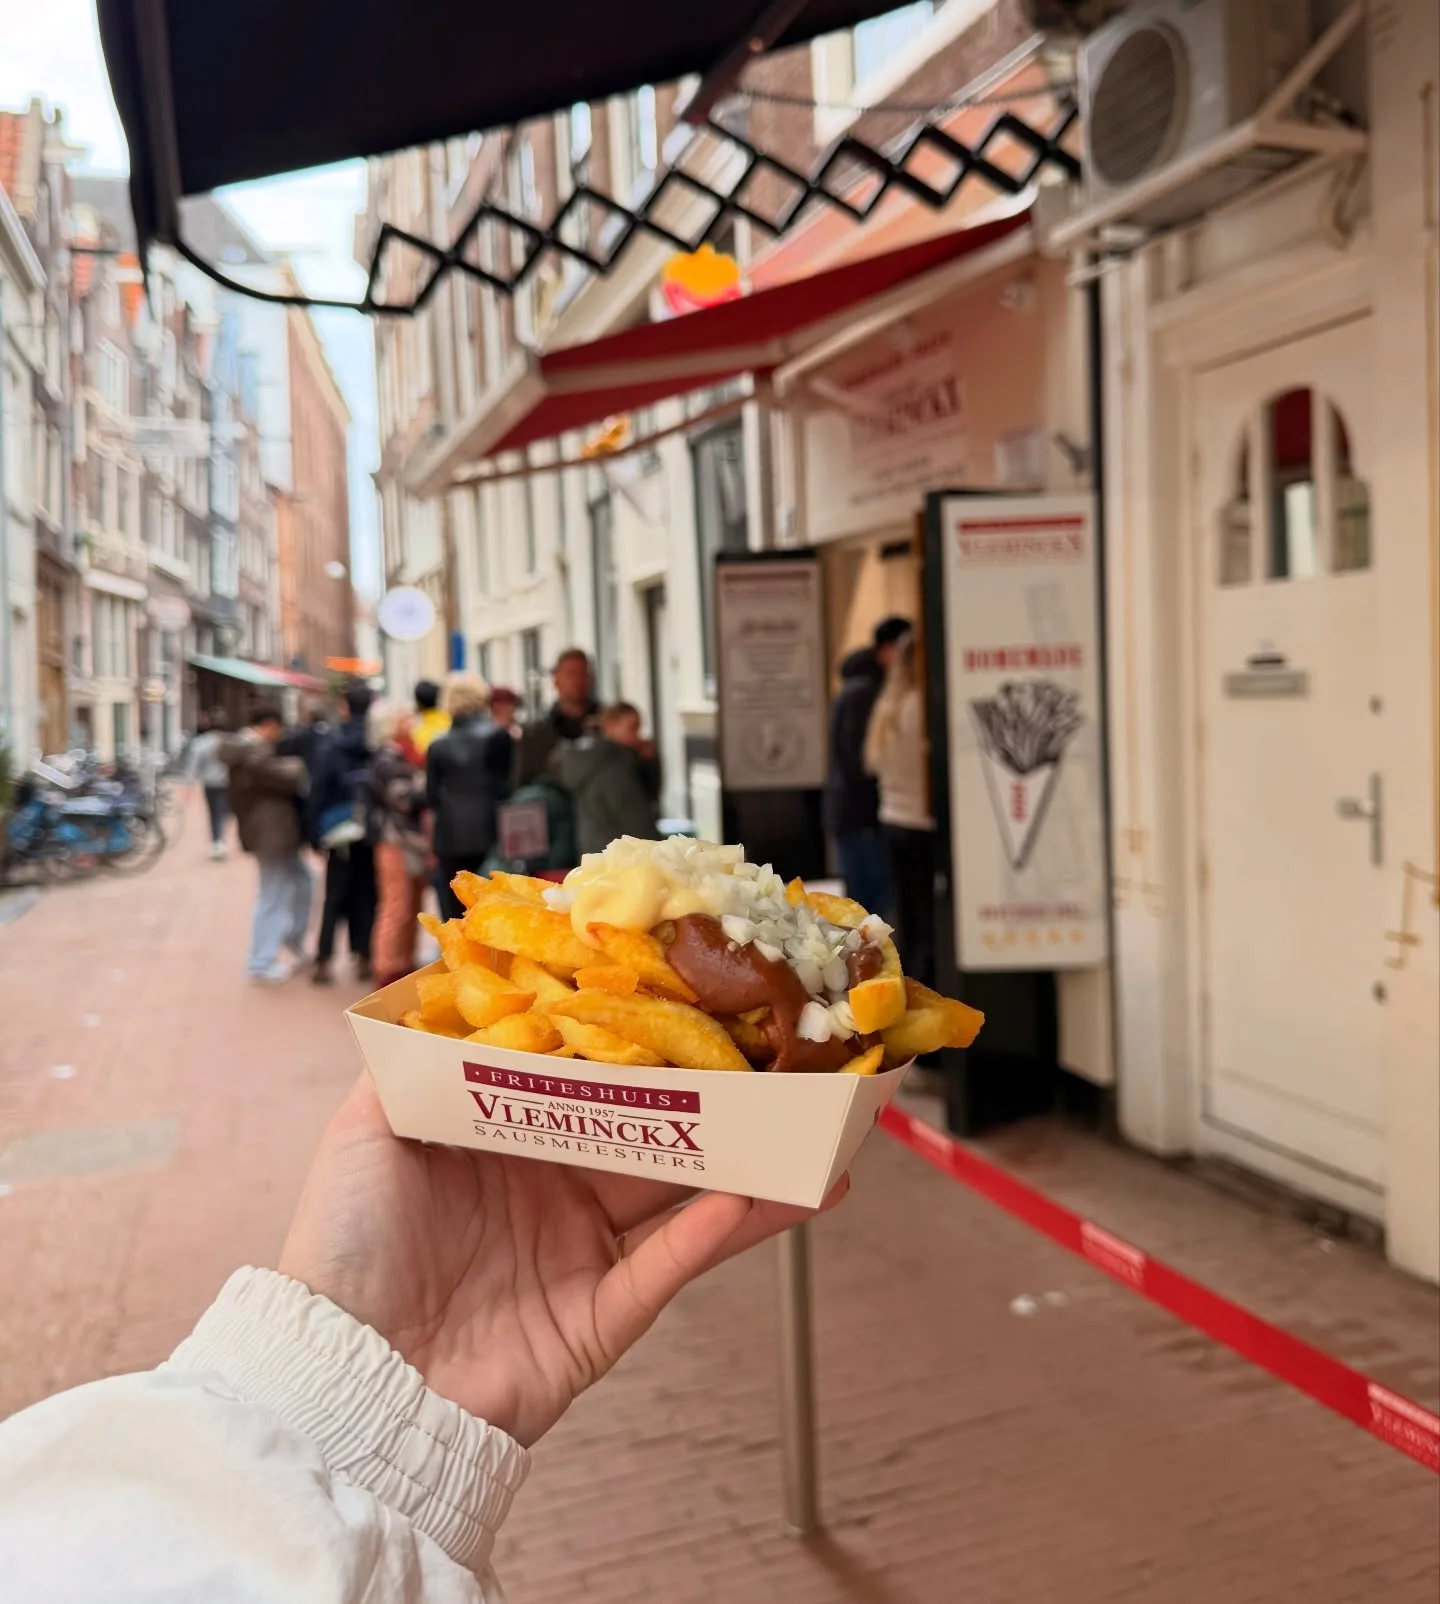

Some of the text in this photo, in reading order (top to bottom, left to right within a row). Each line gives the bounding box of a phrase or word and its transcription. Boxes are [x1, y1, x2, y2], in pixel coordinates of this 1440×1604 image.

[490, 1071, 672, 1106] FRITESHUIS
[467, 1089, 704, 1152] VLEMINCKX
[548, 1101, 615, 1118] ANNO 1957
[474, 1125, 706, 1171] SAUSMEESTERS
